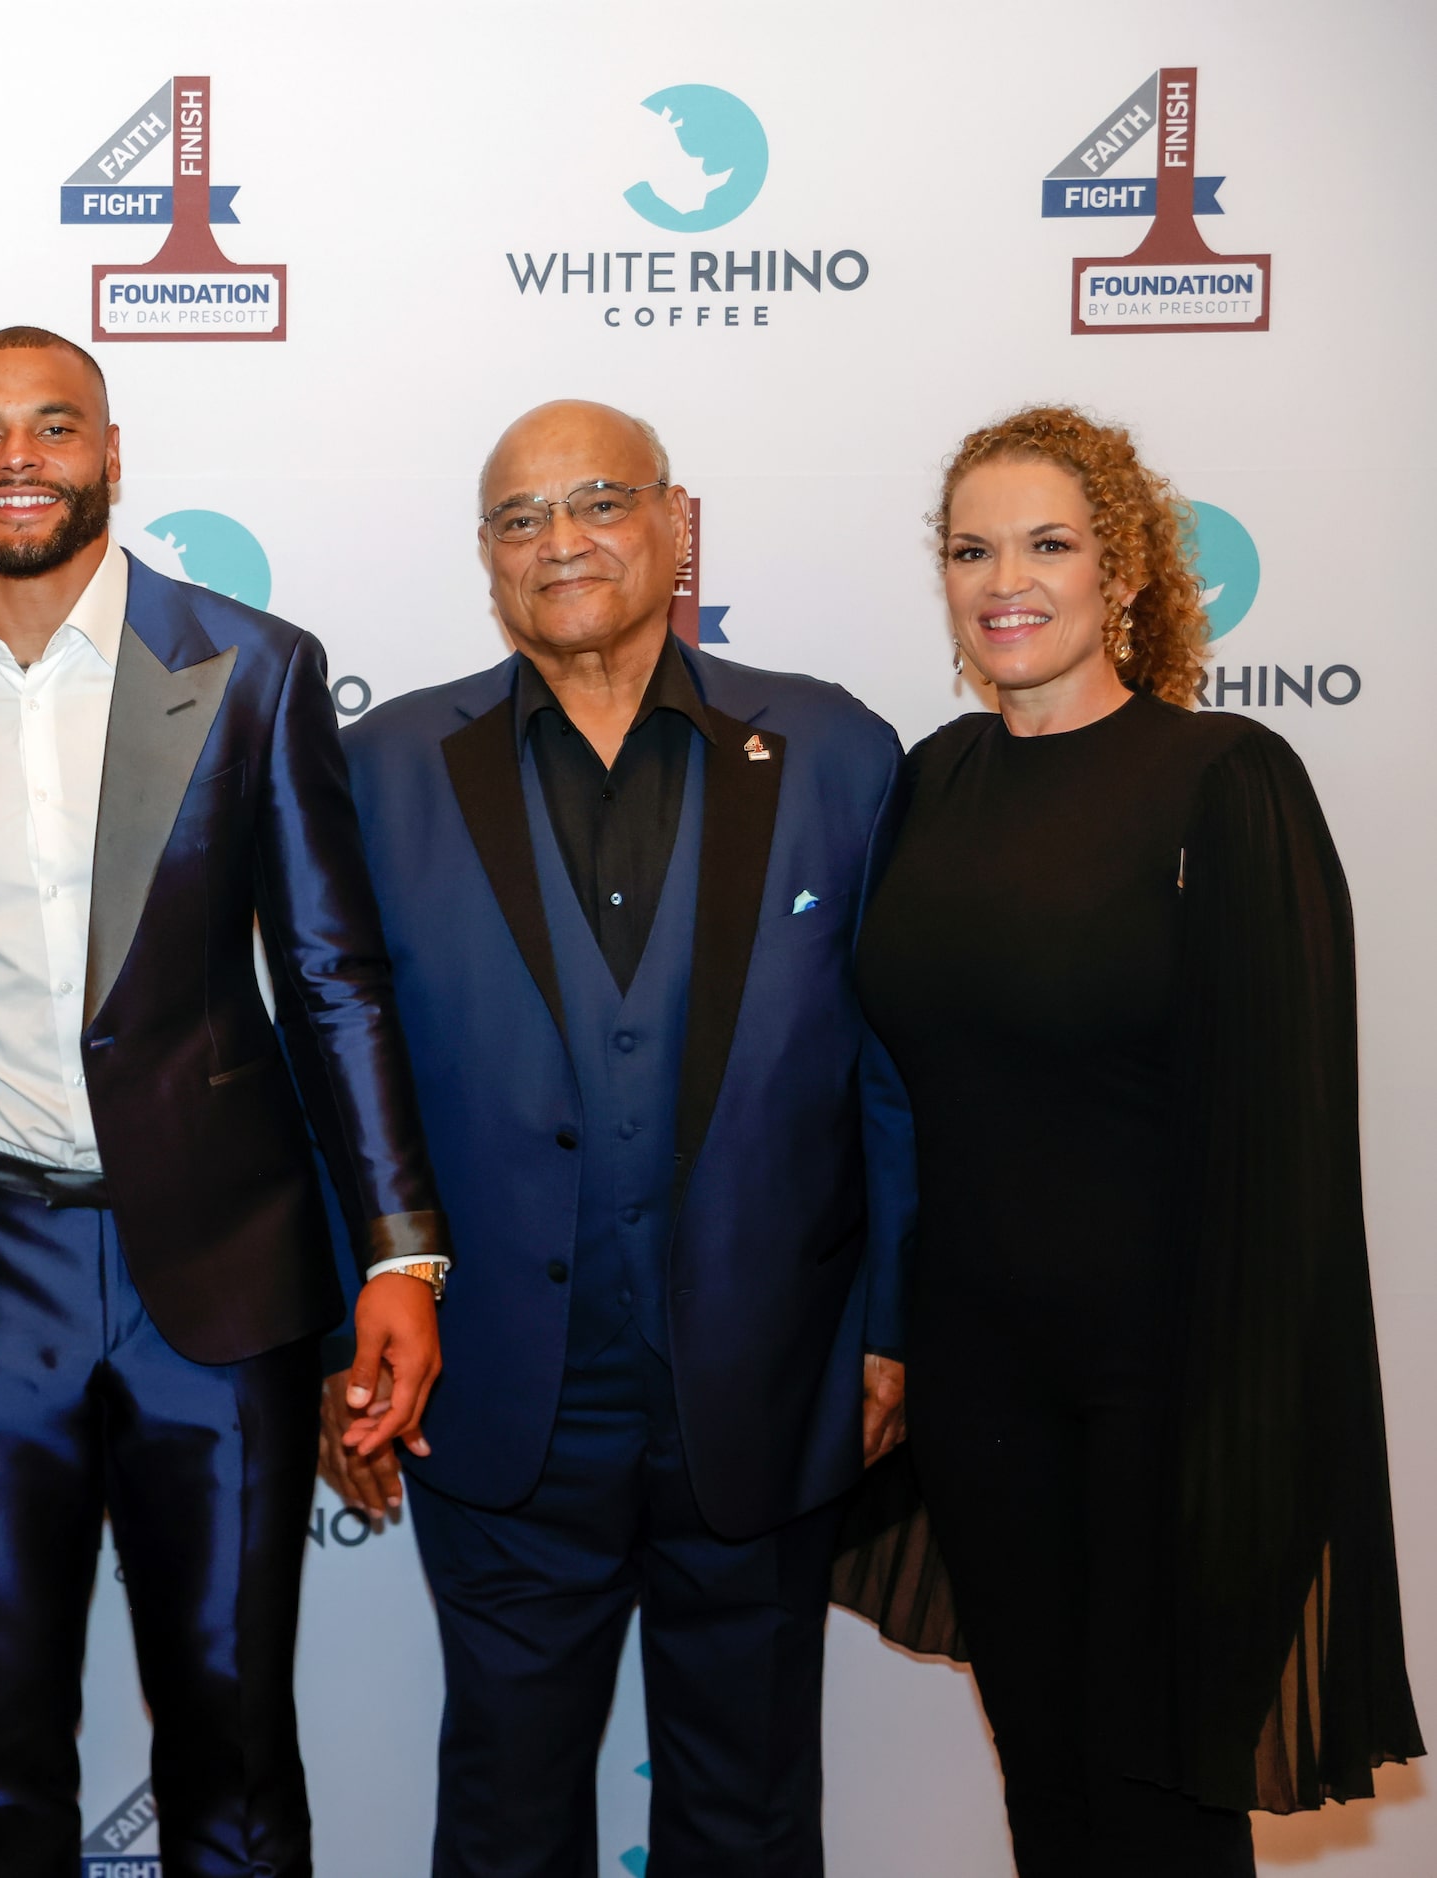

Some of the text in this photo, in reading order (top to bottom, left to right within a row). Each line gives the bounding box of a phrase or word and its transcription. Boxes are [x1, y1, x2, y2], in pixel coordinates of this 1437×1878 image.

[181, 91, 202, 175] FINISH
[1165, 83, 1188, 166] FINISH
[98, 113, 165, 179] FAITH
[1081, 105, 1150, 172] FAITH
[84, 194, 162, 215] FIGHT
[1066, 186, 1146, 208] FIGHT
[506, 249, 869, 294] WHITE RHINO
[110, 284, 269, 304] FOUNDATION
[1091, 275, 1252, 296] FOUNDATION
[109, 311, 268, 323] BY DAK PRESCOTT
[605, 307, 768, 327] COFFEE
[1089, 301, 1250, 316] BY DAK PRESCOTT
